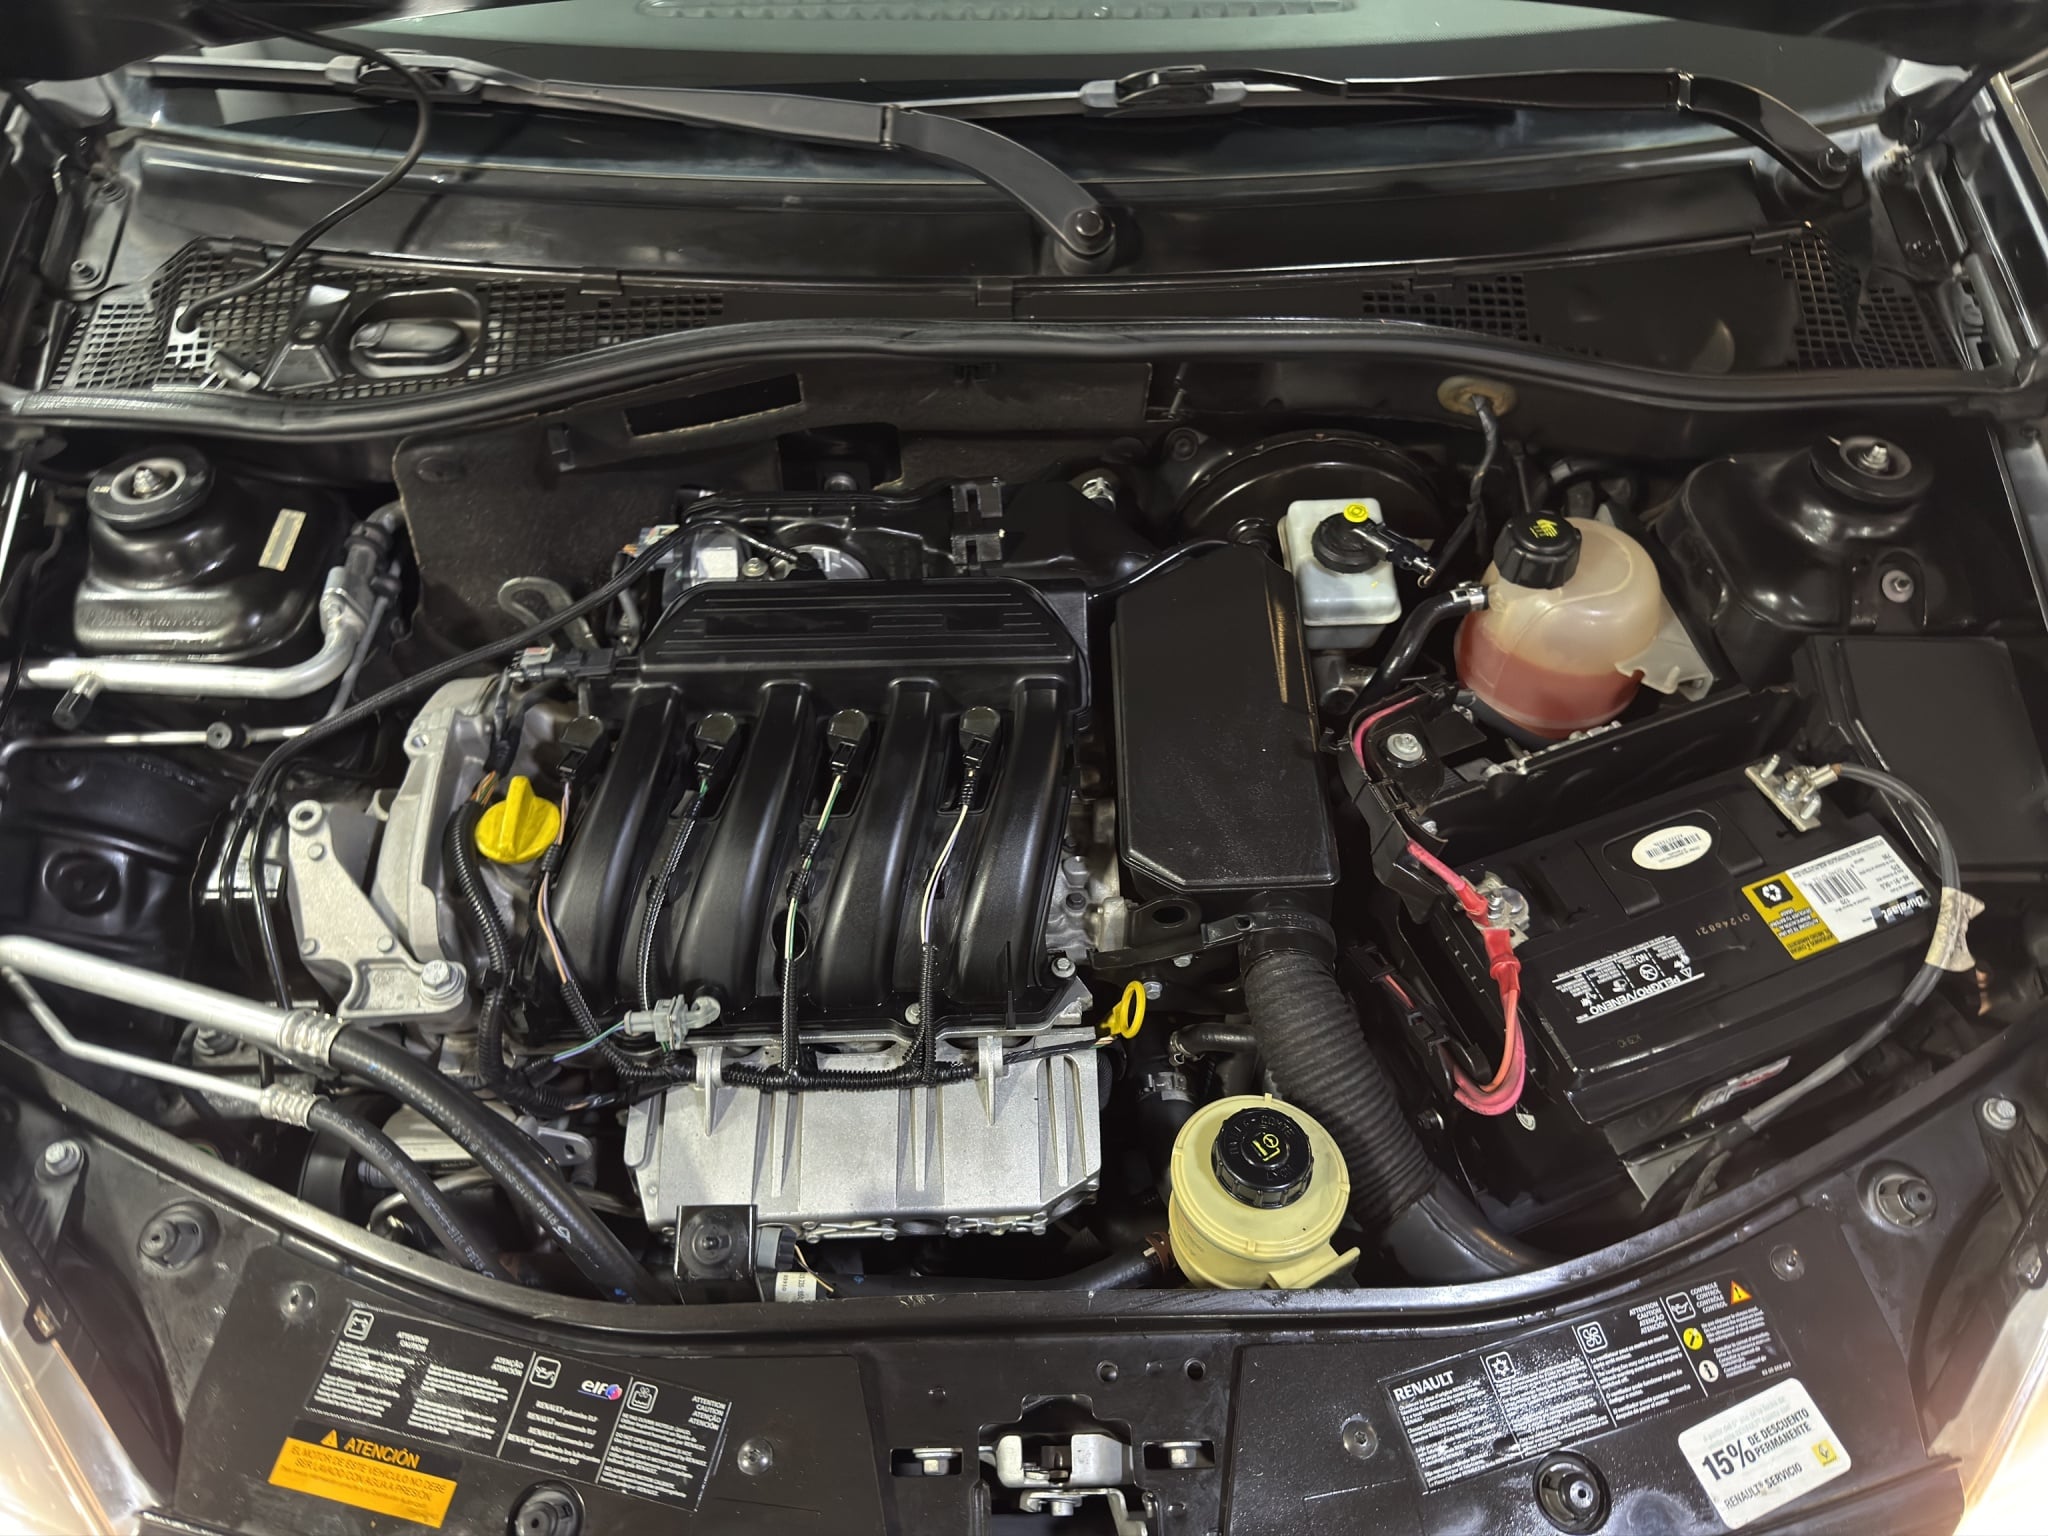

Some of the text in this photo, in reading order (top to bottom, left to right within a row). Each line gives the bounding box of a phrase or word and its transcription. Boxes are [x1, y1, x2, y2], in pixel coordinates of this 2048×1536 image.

[1881, 895, 1924, 920] Duralast
[1589, 975, 1680, 1014] PELIGRO/VENENO
[1696, 1288, 1720, 1300] CONTROL
[1629, 1301, 1658, 1315] ATTENTION
[1636, 1307, 1661, 1320] CAUTION
[1702, 1300, 1727, 1313] CONTROL
[1639, 1313, 1664, 1326] ATENÇÃO
[581, 1380, 608, 1394] elf
[1393, 1370, 1453, 1400] RENAULT
[691, 1395, 725, 1409] ATTENTION
[692, 1410, 721, 1423] ATENÇÃO
[695, 1403, 723, 1416] CAUTION
[1747, 1408, 1808, 1446] DE DESCUENTO
[1754, 1421, 1810, 1456] PERMANENTE
[344, 1438, 419, 1468] ATENCIÓN
[1702, 1439, 1756, 1480] 15%
[1764, 1462, 1802, 1488] SERVICIO
